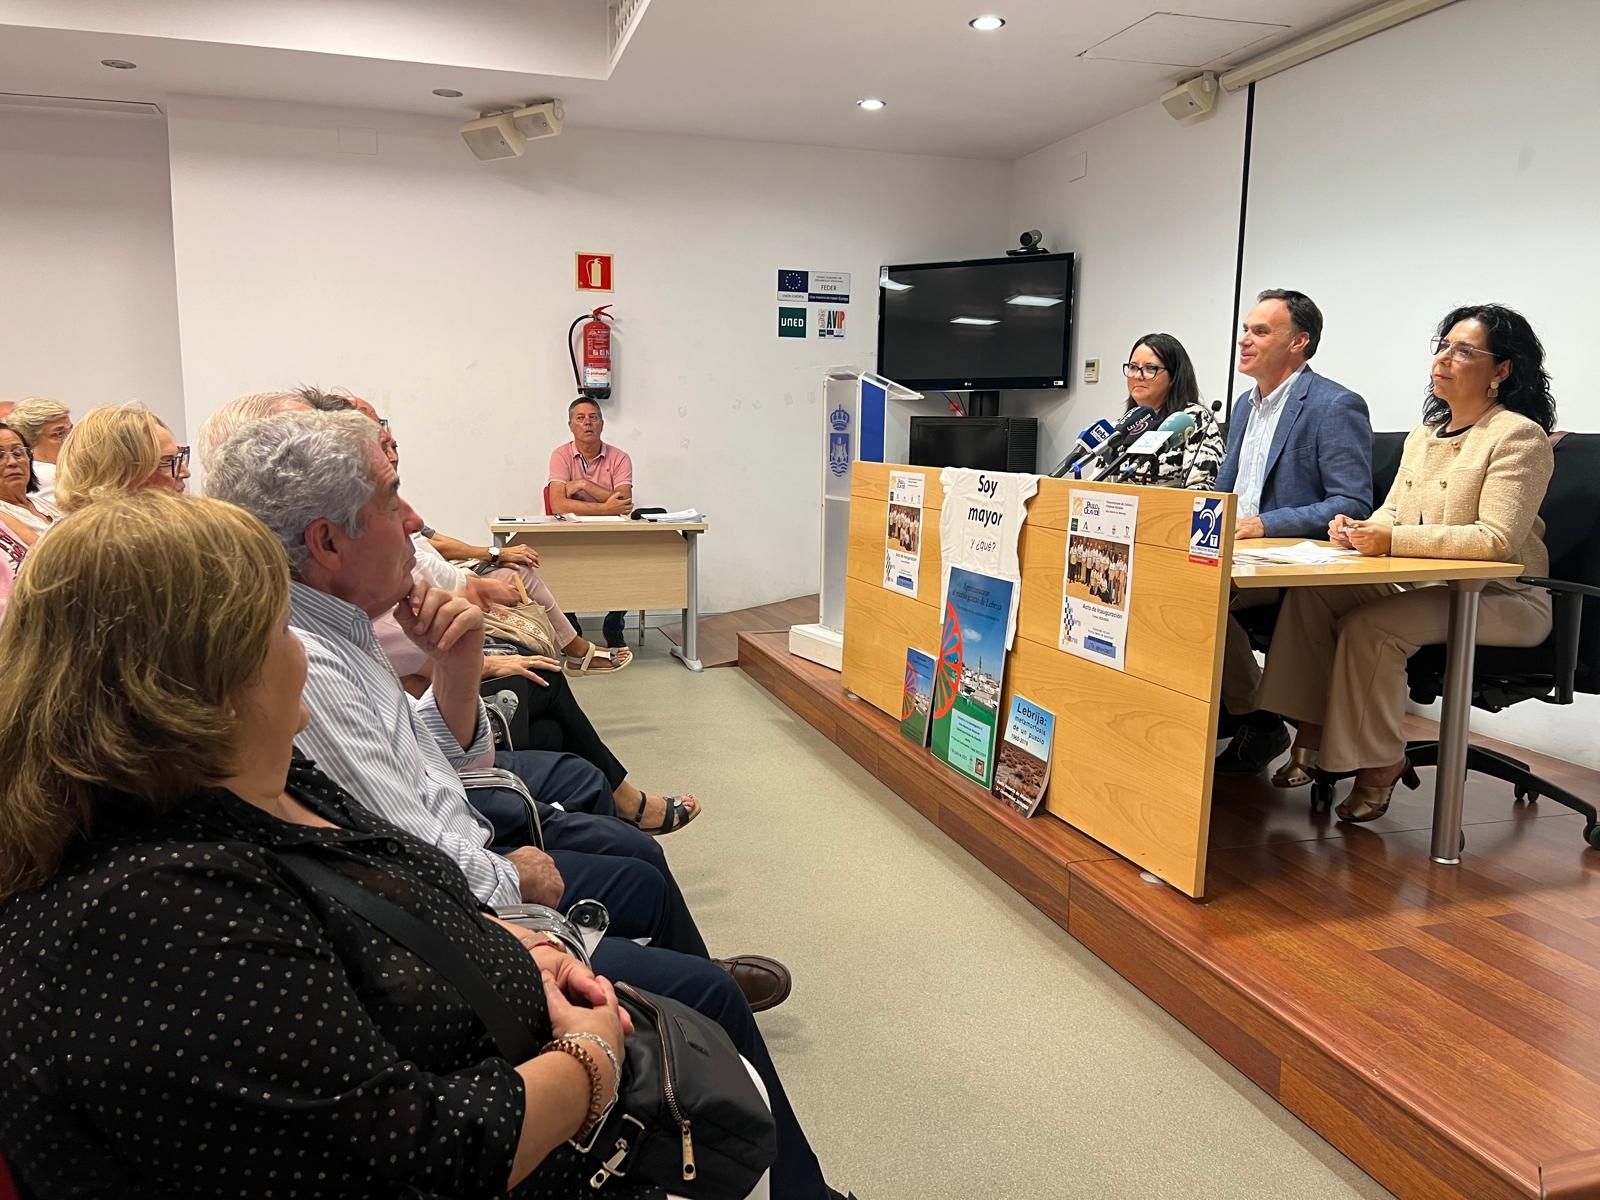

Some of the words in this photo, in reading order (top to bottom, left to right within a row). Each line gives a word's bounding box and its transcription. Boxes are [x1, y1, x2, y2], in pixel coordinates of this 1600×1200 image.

[781, 317, 804, 327] UNED
[826, 310, 845, 329] AVIP
[978, 474, 998, 499] Soy
[968, 507, 1003, 528] mayor
[1211, 536, 1217, 545] T
[1017, 703, 1047, 727] Lebrija:
[1012, 724, 1019, 732] de
[1028, 732, 1045, 745] pueblo
[1014, 716, 1046, 736] metamorfosis
